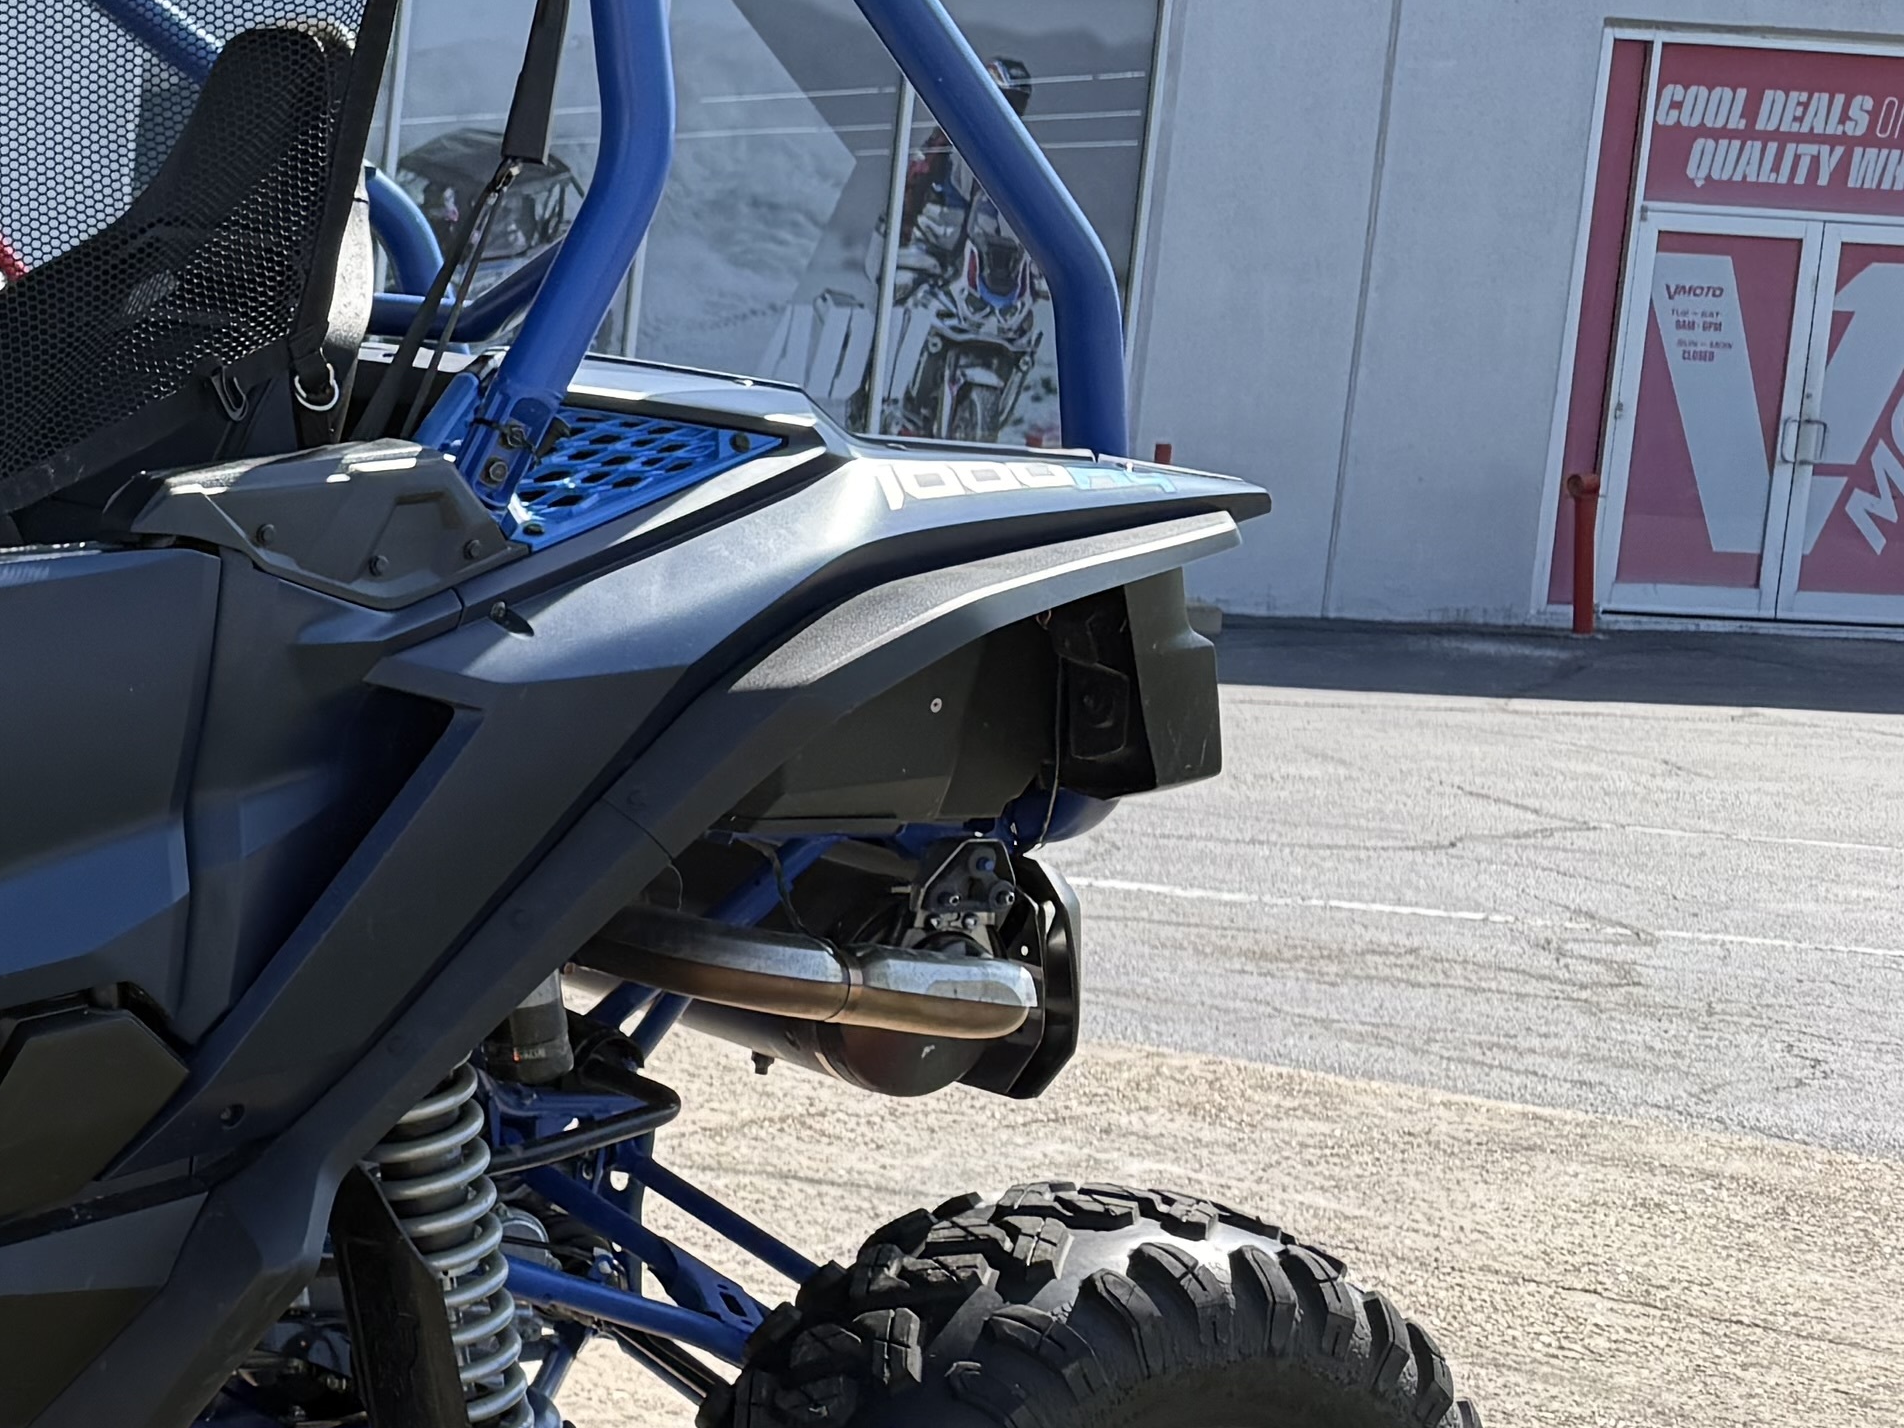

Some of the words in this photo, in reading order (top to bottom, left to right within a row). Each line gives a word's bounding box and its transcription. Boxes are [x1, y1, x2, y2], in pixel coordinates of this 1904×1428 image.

[1655, 84, 1748, 130] COOL
[1755, 89, 1874, 137] DEALS
[1686, 138, 1845, 188] QUALITY
